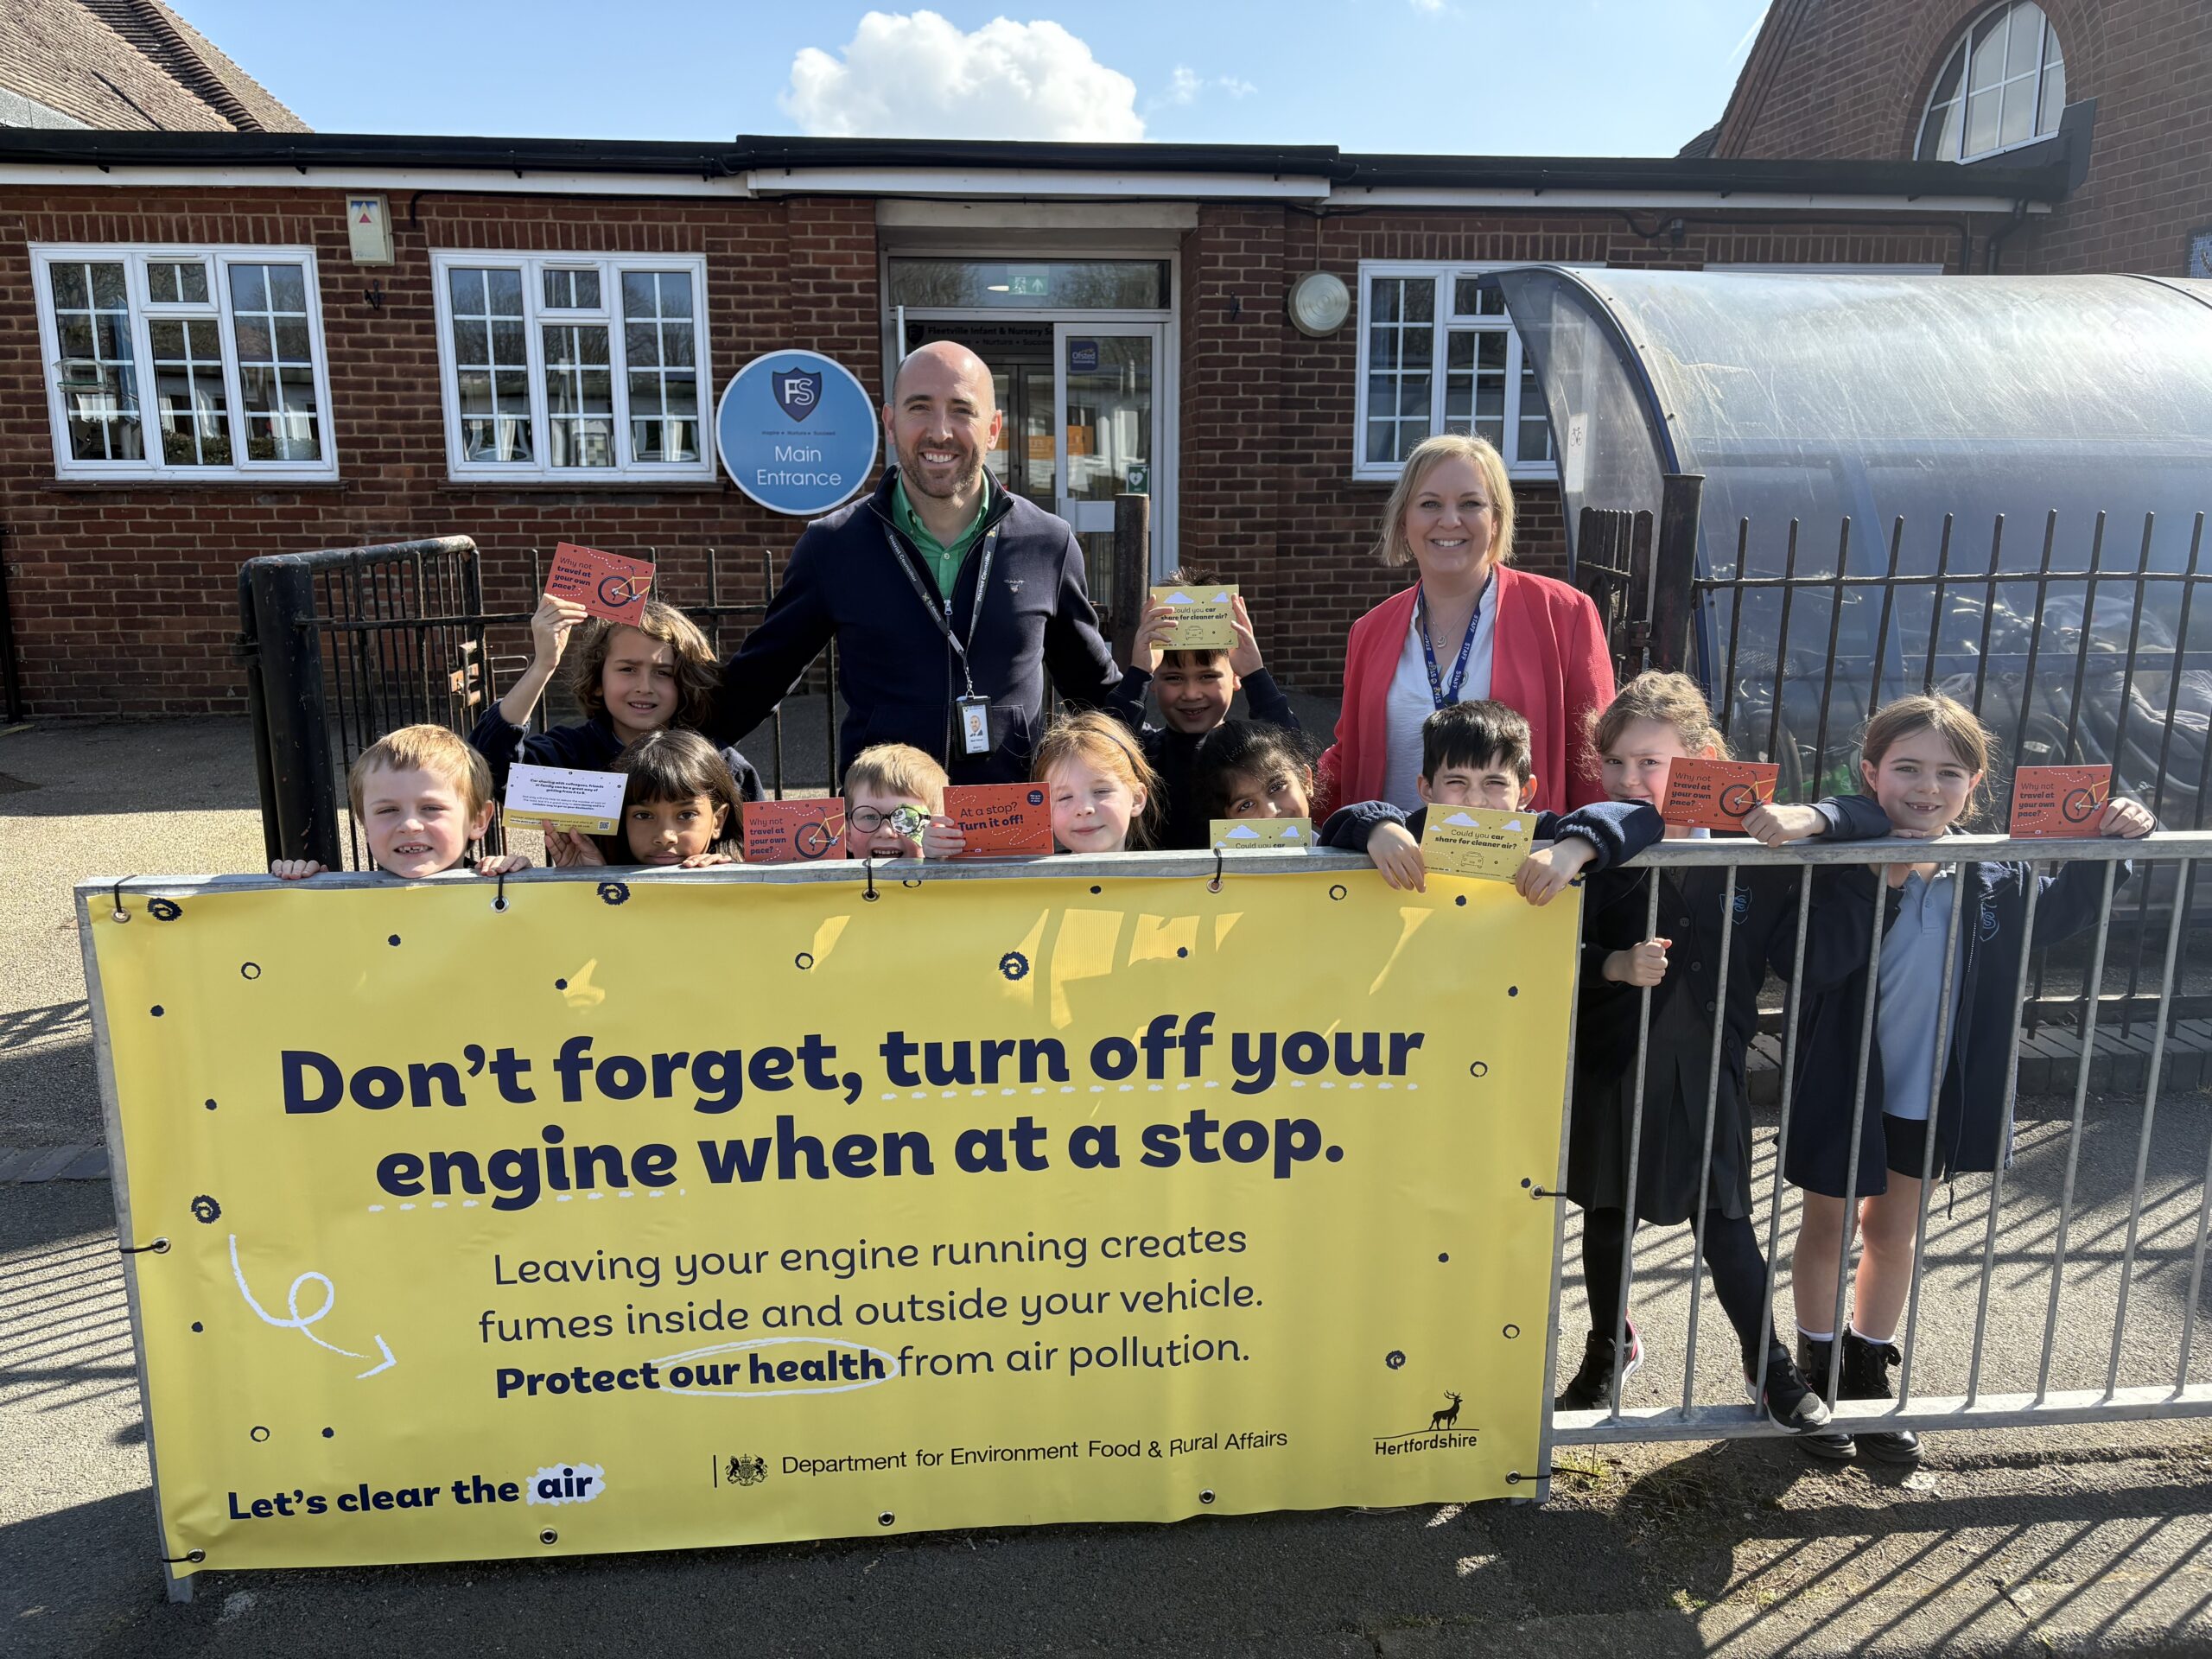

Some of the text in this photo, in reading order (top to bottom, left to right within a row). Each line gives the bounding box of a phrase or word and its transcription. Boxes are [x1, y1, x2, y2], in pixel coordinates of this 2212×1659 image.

[928, 327, 969, 335] Fleetville
[970, 327, 997, 335] Infant
[1008, 327, 1042, 337] Nursery
[1071, 351, 1096, 359] Ofsted
[784, 378, 815, 405] FS
[774, 445, 821, 462] Main
[757, 469, 842, 486] Entrance
[560, 556, 577, 568] Why
[889, 535, 917, 582] District Councillor
[557, 566, 582, 575] travel
[976, 550, 991, 602] District Councillor
[551, 582, 576, 591] pace?
[555, 574, 591, 587] your own
[1469, 614, 1479, 633] STAFF
[1461, 643, 1471, 660] STAFF
[1452, 670, 1462, 690] STAFF
[1674, 781, 1700, 790] travel
[1675, 772, 1694, 782] Why
[960, 808, 974, 818] At
[986, 801, 1018, 815] stop?
[2018, 810, 2042, 819] pace?
[749, 818, 767, 827] Why
[957, 814, 1024, 831] Turn it off!
[750, 827, 774, 836] travel
[1451, 829, 1473, 837] Could
[750, 838, 769, 847] your
[1434, 836, 1458, 844] share
[1471, 839, 1501, 848] cleaner
[750, 847, 773, 856] pace?
[281, 1011, 1425, 1114] Don’t forget, turn off your
[376, 1109, 1344, 1211] engine when at a stop.
[494, 1226, 1247, 1287] Leaving your engine running creates
[479, 1276, 1263, 1344] fumes inside and outside your vehicle.
[496, 1333, 1249, 1399] Protect our health from air pollution.
[1375, 1433, 1478, 1455] Hertfordshire
[782, 1430, 1287, 1477] Department for Environment Food & Rural Affairs
[228, 1467, 594, 1520] Let’s clear the air
